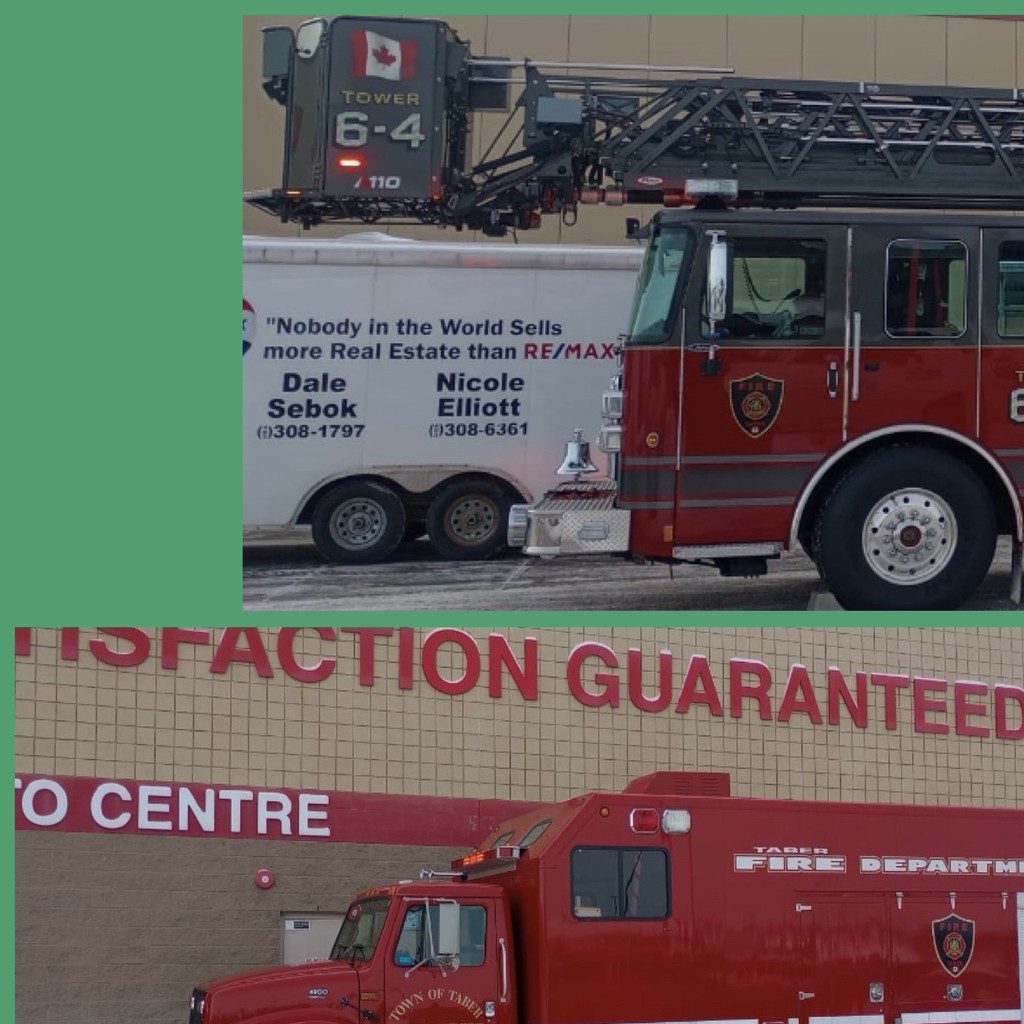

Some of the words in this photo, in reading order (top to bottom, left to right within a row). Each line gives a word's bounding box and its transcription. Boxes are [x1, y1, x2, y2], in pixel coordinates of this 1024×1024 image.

[342, 90, 420, 106] TOWER
[335, 111, 425, 148] 6-4
[266, 317, 361, 338] "Nobody
[369, 318, 388, 335] in
[396, 319, 432, 336] the
[440, 319, 502, 336] World
[510, 320, 562, 336] Sells
[263, 346, 322, 359] more
[331, 343, 381, 359] Real
[389, 343, 461, 360] Estate
[468, 343, 517, 360] than
[524, 343, 614, 360] RE/MAX
[282, 372, 346, 392] Dale
[437, 372, 525, 392] Nicole
[267, 399, 357, 418] Sebok
[438, 398, 521, 417] Elliott
[15, 778, 68, 827] O
[90, 782, 331, 837] CENTRE
[734, 854, 847, 873] FIRE
[939, 922, 968, 931] FIRE
[388, 991, 424, 1021] TOWN
[428, 988, 445, 1000] OF
[448, 989, 484, 1019] TABER
